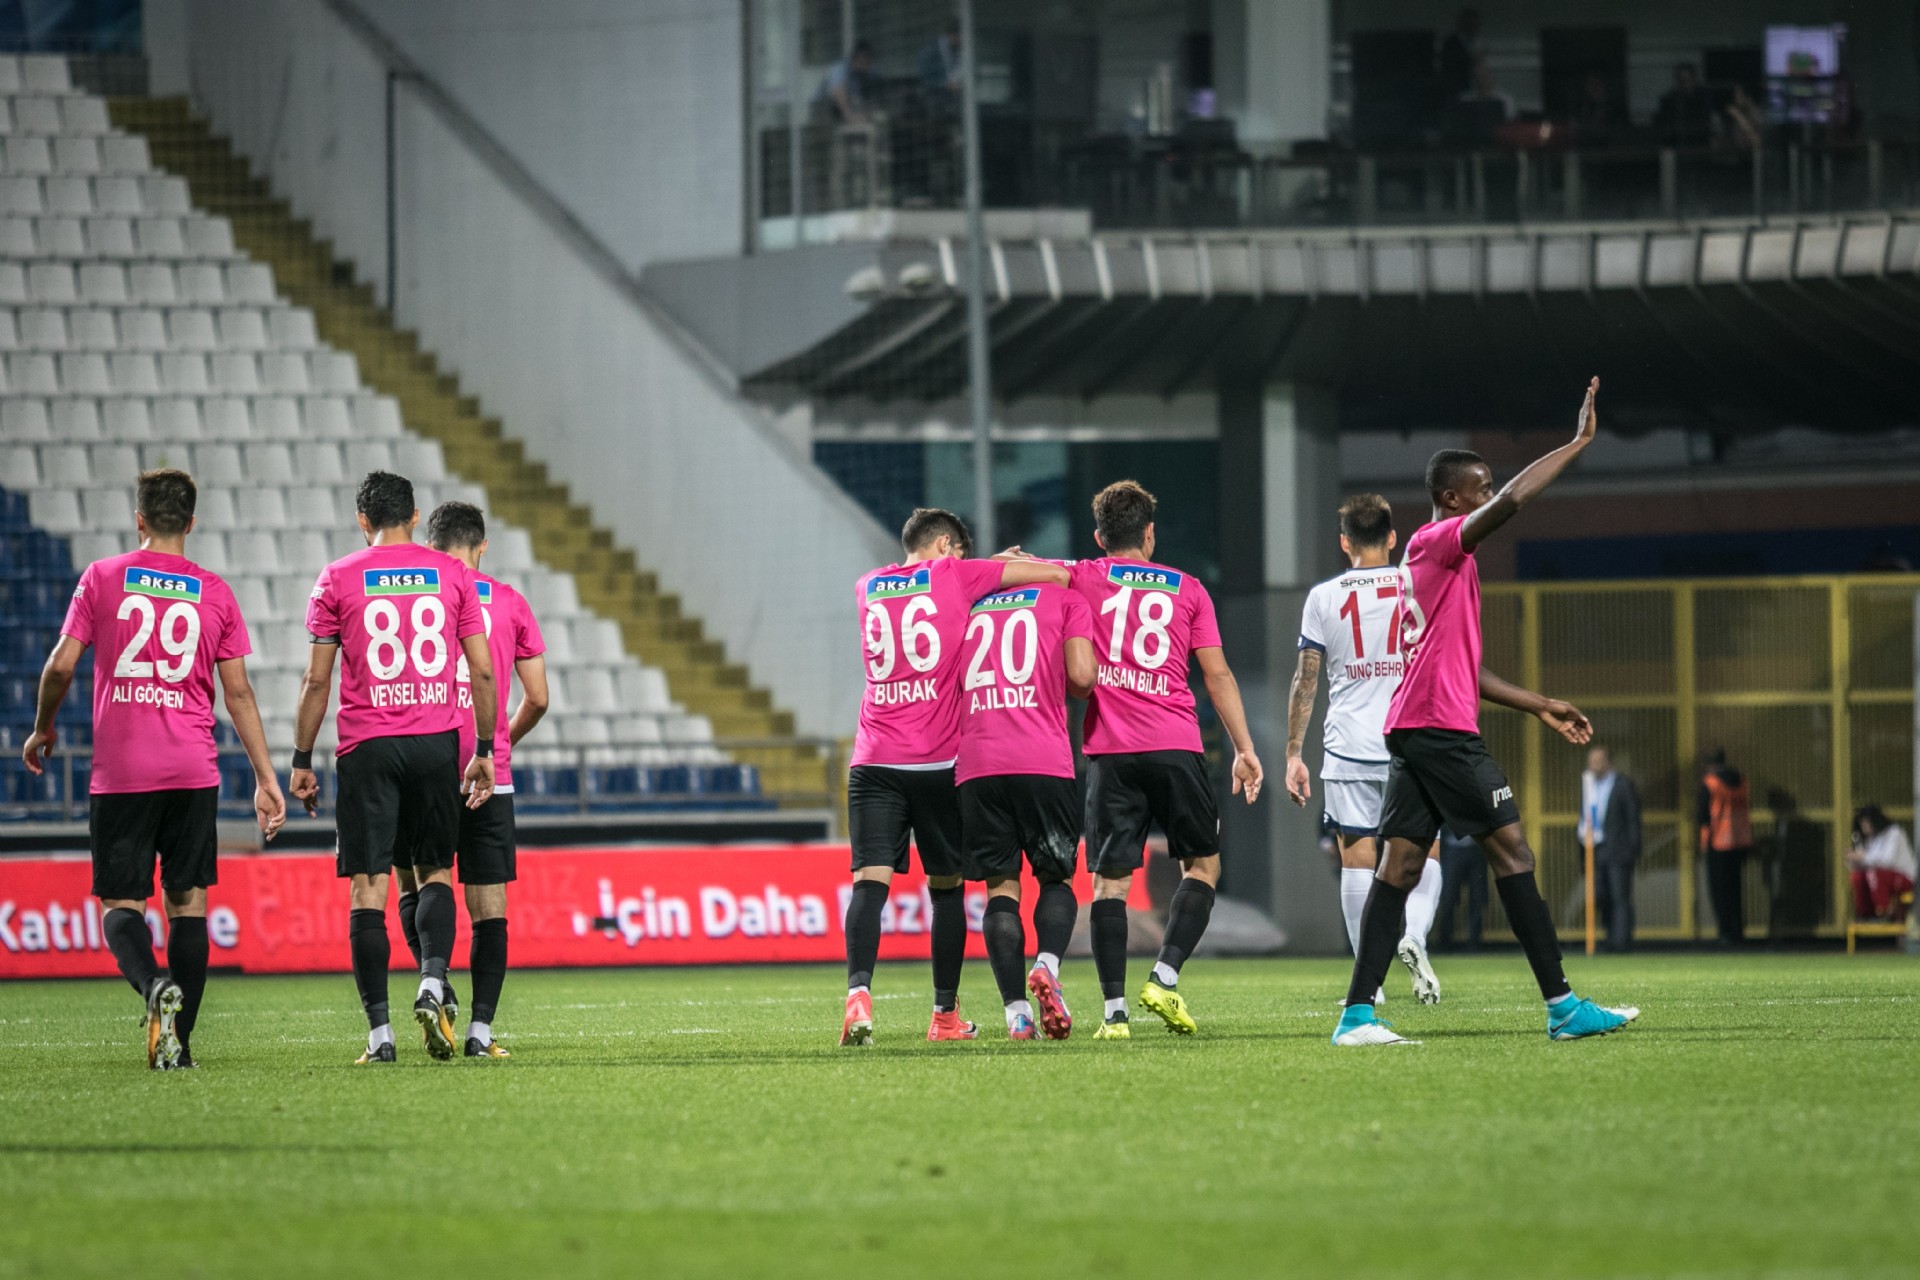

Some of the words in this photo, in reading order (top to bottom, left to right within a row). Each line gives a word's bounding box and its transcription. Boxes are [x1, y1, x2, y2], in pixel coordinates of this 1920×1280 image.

[139, 574, 187, 592] aksa
[378, 573, 425, 587] aksa
[875, 577, 917, 592] aksa
[1122, 571, 1167, 584] aksa
[983, 593, 1025, 606] aksa
[1100, 585, 1174, 669] 18
[1340, 586, 1401, 659] 17
[114, 594, 200, 683] 29
[363, 595, 447, 681] 88
[866, 595, 941, 681] 96
[965, 608, 1038, 691] 20
[1097, 664, 1136, 690] HASAN
[1344, 662, 1372, 680] TUNÇ
[112, 681, 132, 703] ALİ
[370, 683, 418, 708] VEYSEL
[420, 682, 447, 705] SARI
[874, 678, 938, 705] BURAK
[700, 884, 829, 938] Daha
